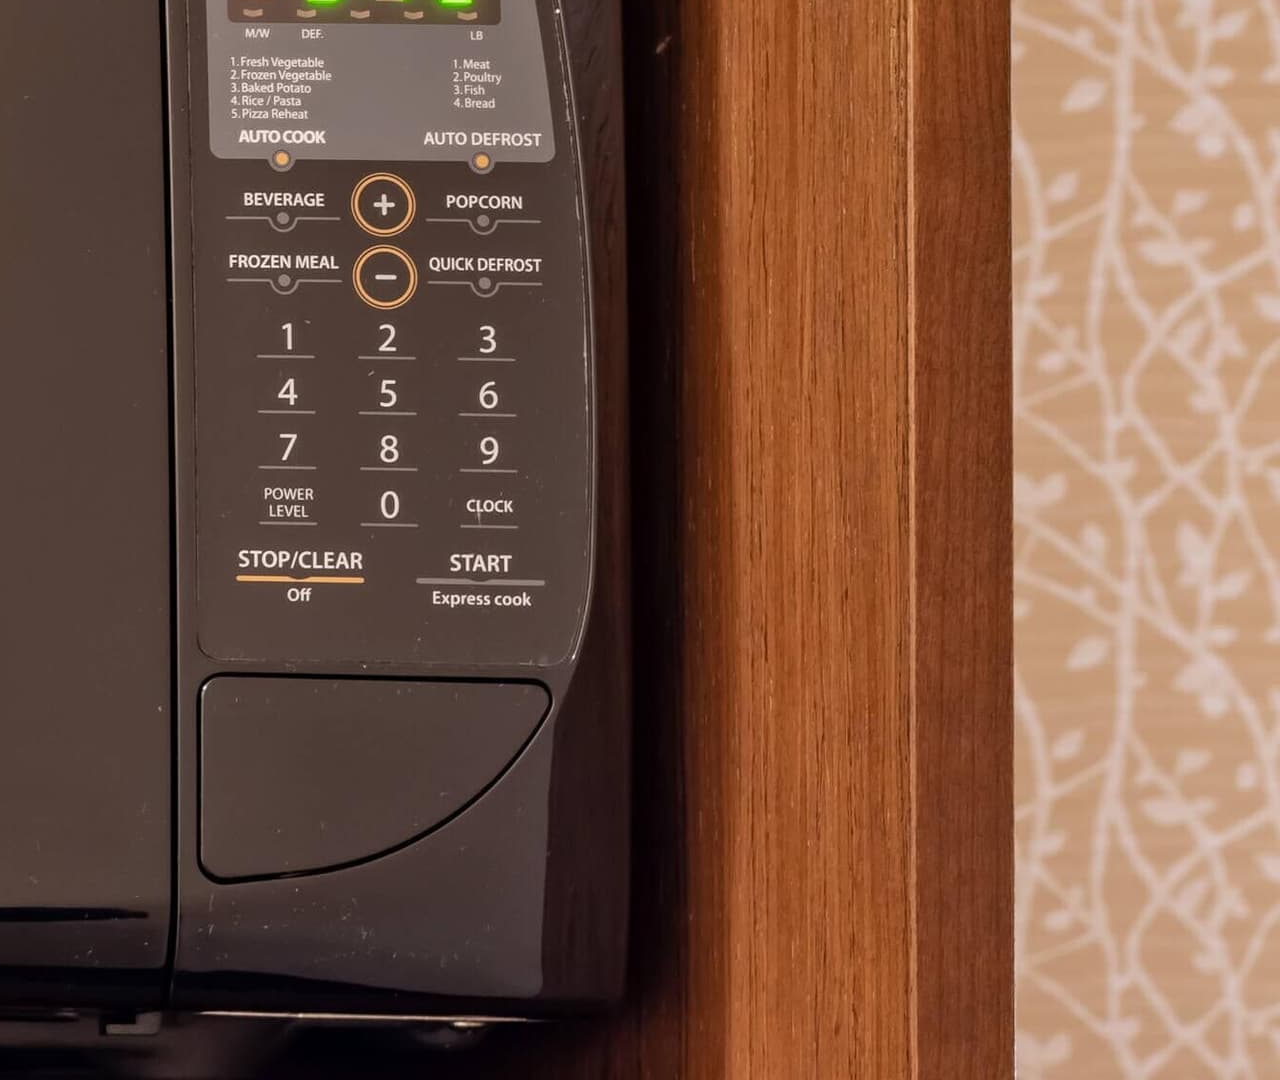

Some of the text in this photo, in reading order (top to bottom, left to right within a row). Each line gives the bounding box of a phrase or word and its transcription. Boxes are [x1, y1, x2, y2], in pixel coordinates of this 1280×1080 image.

[245, 28, 270, 38] M/W
[470, 31, 483, 40] LB
[271, 57, 324, 69] Vegetable
[279, 70, 332, 83] Vegetable
[277, 83, 312, 93] Potato
[273, 96, 302, 106] Pasta
[272, 109, 308, 119] Reheat
[239, 130, 326, 144] AUTO COOK
[424, 132, 542, 146] AUTO DEFROST
[243, 193, 325, 208] BEVERAGE
[446, 195, 523, 210] POPCORN
[229, 254, 339, 270] FROZEN MEAL
[429, 257, 542, 273] QUICK DEFROST
[281, 323, 293, 350] 1
[378, 325, 397, 352] 2
[479, 326, 496, 353] 3
[278, 379, 298, 406] 4
[380, 380, 397, 407] 5
[479, 382, 498, 408] 6
[280, 434, 297, 461] 7
[380, 435, 399, 462] 8
[480, 437, 498, 464] 9
[264, 488, 314, 501] POWER
[269, 505, 309, 518] LEVEL
[380, 491, 400, 519] 0
[466, 500, 513, 513] CLOCK
[238, 551, 363, 569] STOP/CLEAR
[450, 555, 512, 571] START
[287, 589, 312, 602] Off
[433, 591, 532, 608] Express cook
